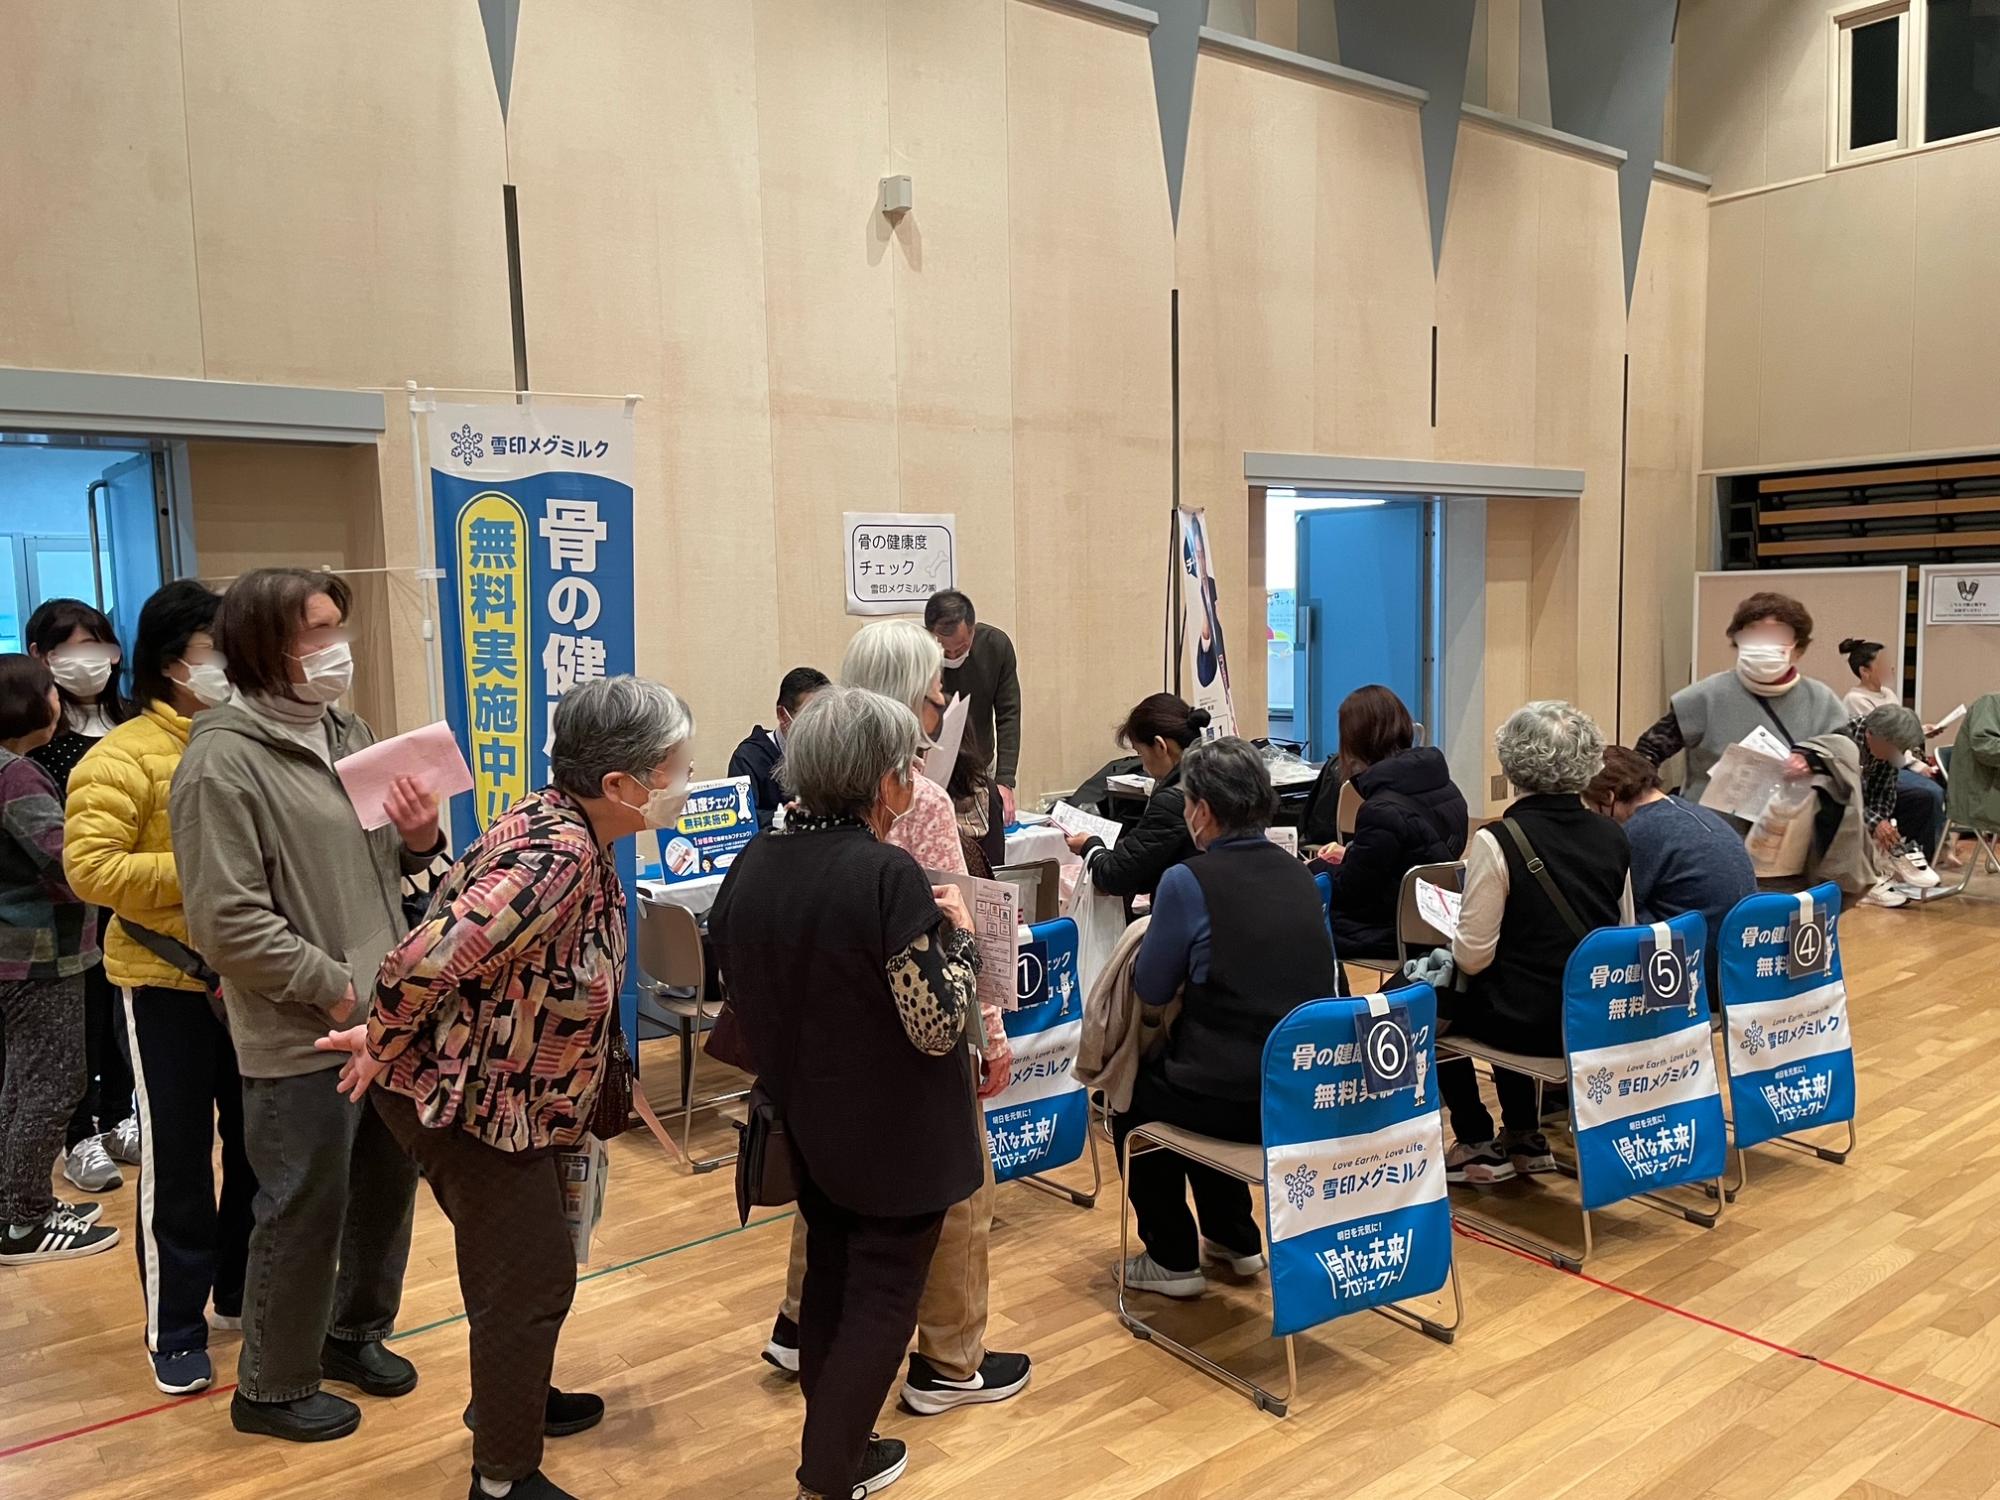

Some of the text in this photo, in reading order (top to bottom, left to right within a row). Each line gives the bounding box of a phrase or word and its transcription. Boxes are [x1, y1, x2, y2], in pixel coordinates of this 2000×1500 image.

[491, 434, 608, 459] 雪印メグミルク
[858, 533, 928, 551] 骨の健康度
[859, 560, 915, 576] チェック
[539, 499, 607, 759] 骨の健
[1768, 1016, 1839, 1050] 雪印メグミルク
[1618, 1060, 1700, 1097] 雪印メグミルク
[1626, 1063, 1645, 1073] Love
[1764, 1073, 1827, 1110] 骨太な未来
[1332, 1141, 1427, 1171] Love Earth. Love Life.
[1619, 1123, 1690, 1165] 骨太な未来
[1323, 1158, 1428, 1200] 雪印メグミルク
[1337, 1221, 1382, 1241] 明日を元気に!
[1323, 1232, 1405, 1281] 骨太な未来
